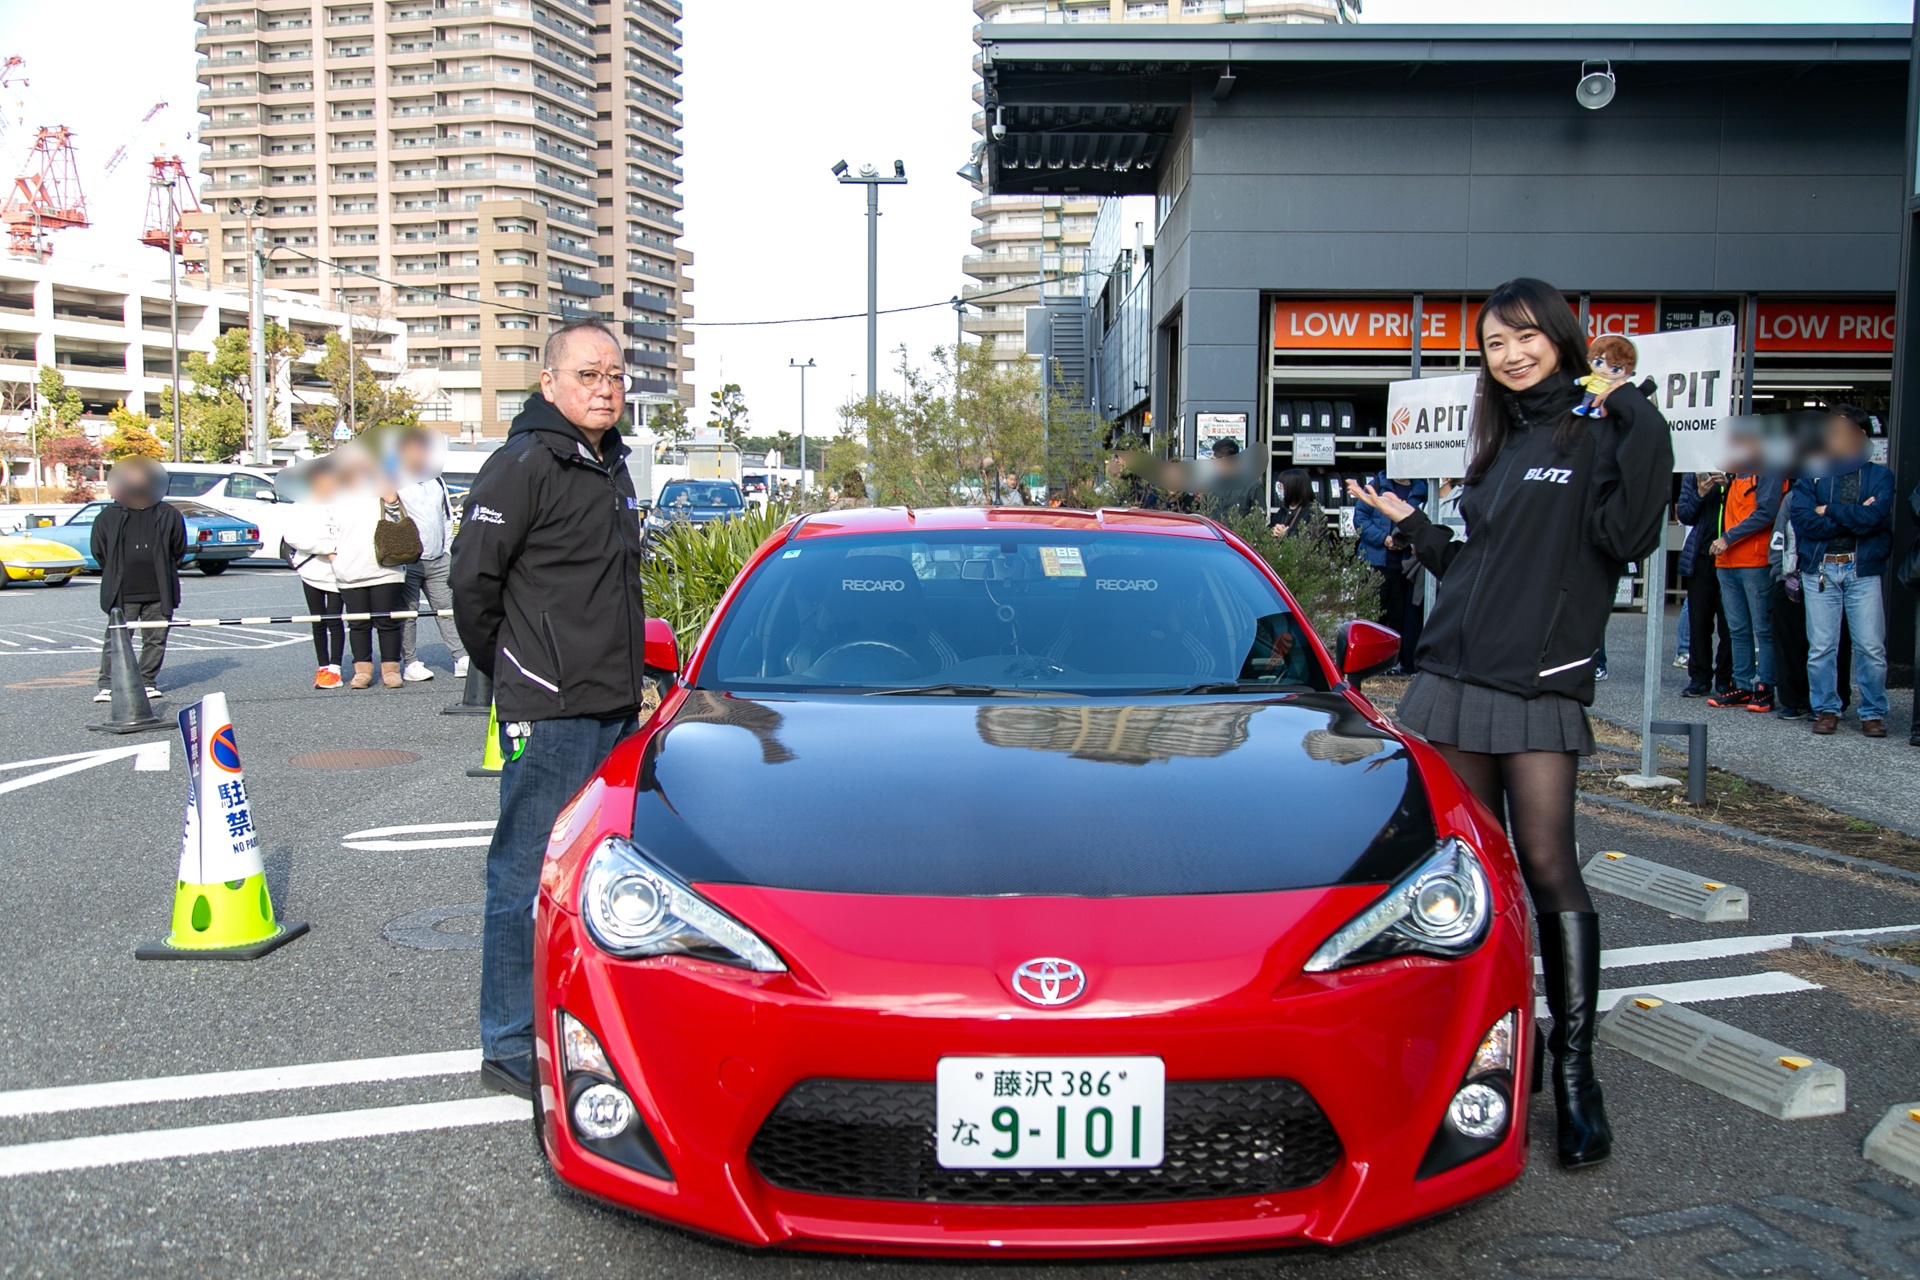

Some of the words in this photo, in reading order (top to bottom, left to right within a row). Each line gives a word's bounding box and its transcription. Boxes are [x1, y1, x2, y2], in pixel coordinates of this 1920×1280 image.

[1290, 312, 1360, 337] LOW
[1368, 312, 1447, 338] PRICE
[1759, 315, 1830, 339] LOW
[1415, 405, 1468, 434] APIT
[1391, 441, 1423, 451] AUTOBACS
[1424, 439, 1466, 449] SHINONOME
[1523, 467, 1573, 484] BLITZ
[1055, 547, 1080, 557] 86
[842, 579, 906, 592] RECARO
[1095, 579, 1159, 591] RECARO
[217, 779, 248, 809] 駐
[232, 841, 246, 854] NO
[993, 1070, 1053, 1098] 藤沢
[1061, 1071, 1112, 1097] 386
[951, 1118, 981, 1147] な
[991, 1105, 1142, 1160] 9-101
